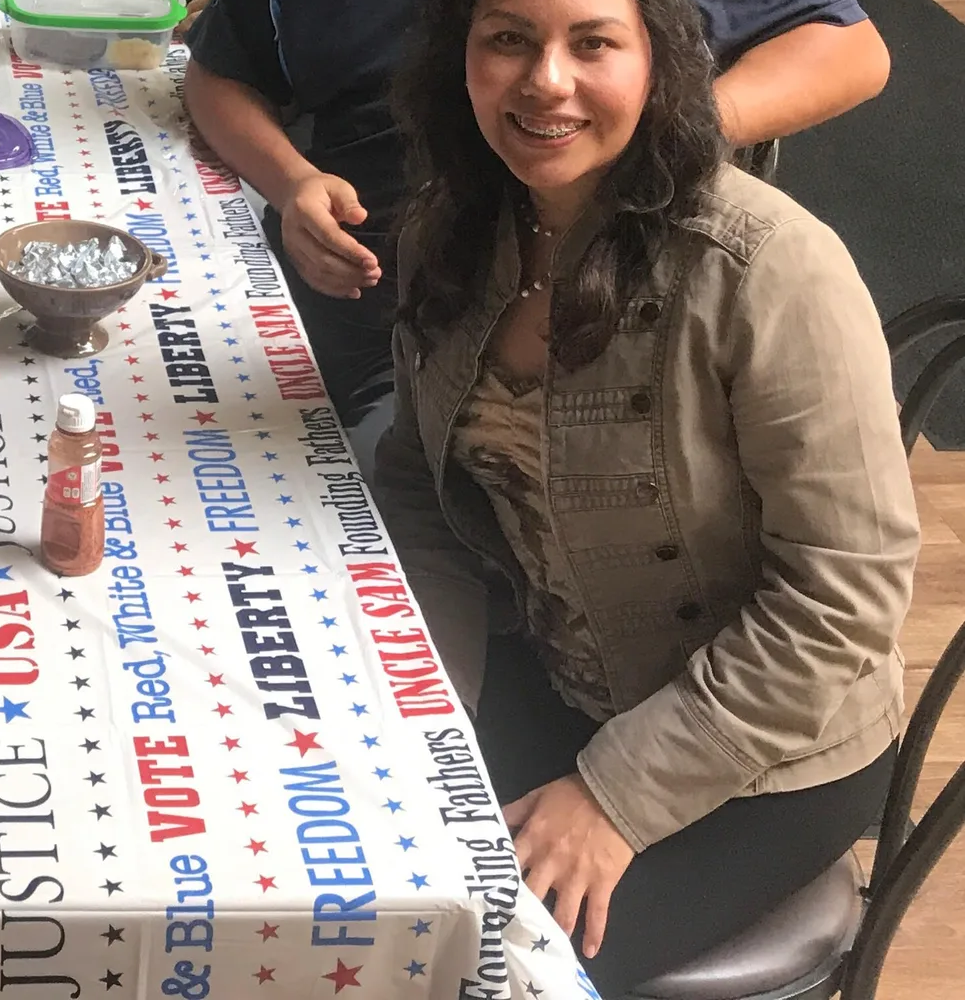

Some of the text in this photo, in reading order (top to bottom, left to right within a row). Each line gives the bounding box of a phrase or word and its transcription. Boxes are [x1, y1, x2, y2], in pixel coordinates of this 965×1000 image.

[19, 83, 46, 111] Blue
[104, 119, 157, 195] LIBERTY
[217, 198, 260, 239] Fathers
[232, 241, 285, 299] Founding
[149, 303, 220, 404] LIBERTY
[249, 304, 303, 343] SAM
[265, 347, 326, 401] UNCLE
[298, 406, 353, 467] Fathers
[183, 428, 260, 534] FREEDOM
[317, 473, 388, 557] Founding
[108, 565, 158, 649] White
[344, 562, 419, 621] SAM
[221, 562, 321, 720] LIBERTY
[371, 628, 455, 720] UNCLE
[119, 650, 174, 723] Red,
[133, 735, 206, 843] VOTE
[425, 727, 498, 828] Fathers
[279, 760, 377, 947] FREEDOM
[165, 854, 215, 953] Blue
[161, 959, 211, 999] &
